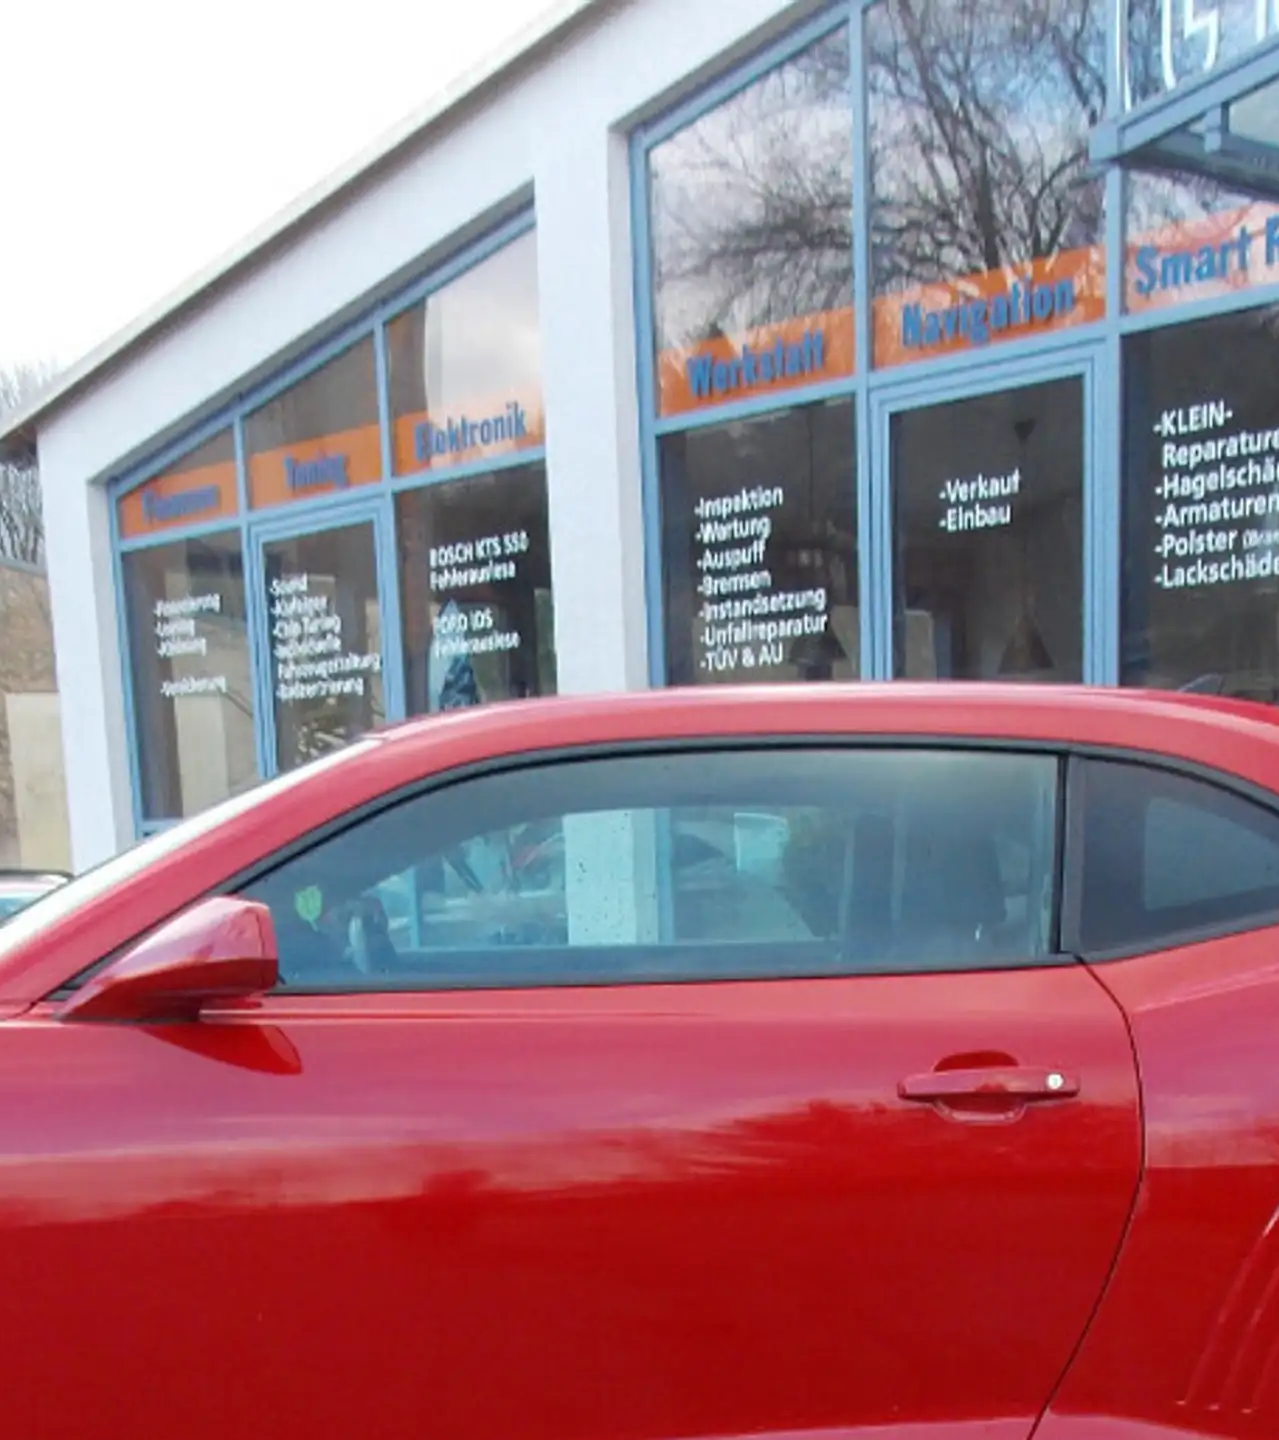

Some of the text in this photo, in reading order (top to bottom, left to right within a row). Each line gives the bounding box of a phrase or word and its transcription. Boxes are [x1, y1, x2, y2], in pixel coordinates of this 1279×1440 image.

[1135, 226, 1251, 297] Smart
[900, 274, 1077, 348] Navigation
[687, 328, 827, 397] Werkstatt
[414, 401, 528, 463] Elektronik
[939, 466, 1020, 503] -Verkauf
[694, 486, 784, 519] -Inspektion
[939, 501, 1012, 532] -Einbau
[695, 516, 771, 545] -Wartung
[1154, 529, 1238, 558] -Polster
[429, 541, 474, 568] BOSCH
[696, 540, 766, 571] -Auspuff
[697, 570, 771, 597] -Bremsen
[698, 587, 827, 622] -Instandsetzung
[742, 647, 755, 667] &
[758, 642, 784, 666] AU
